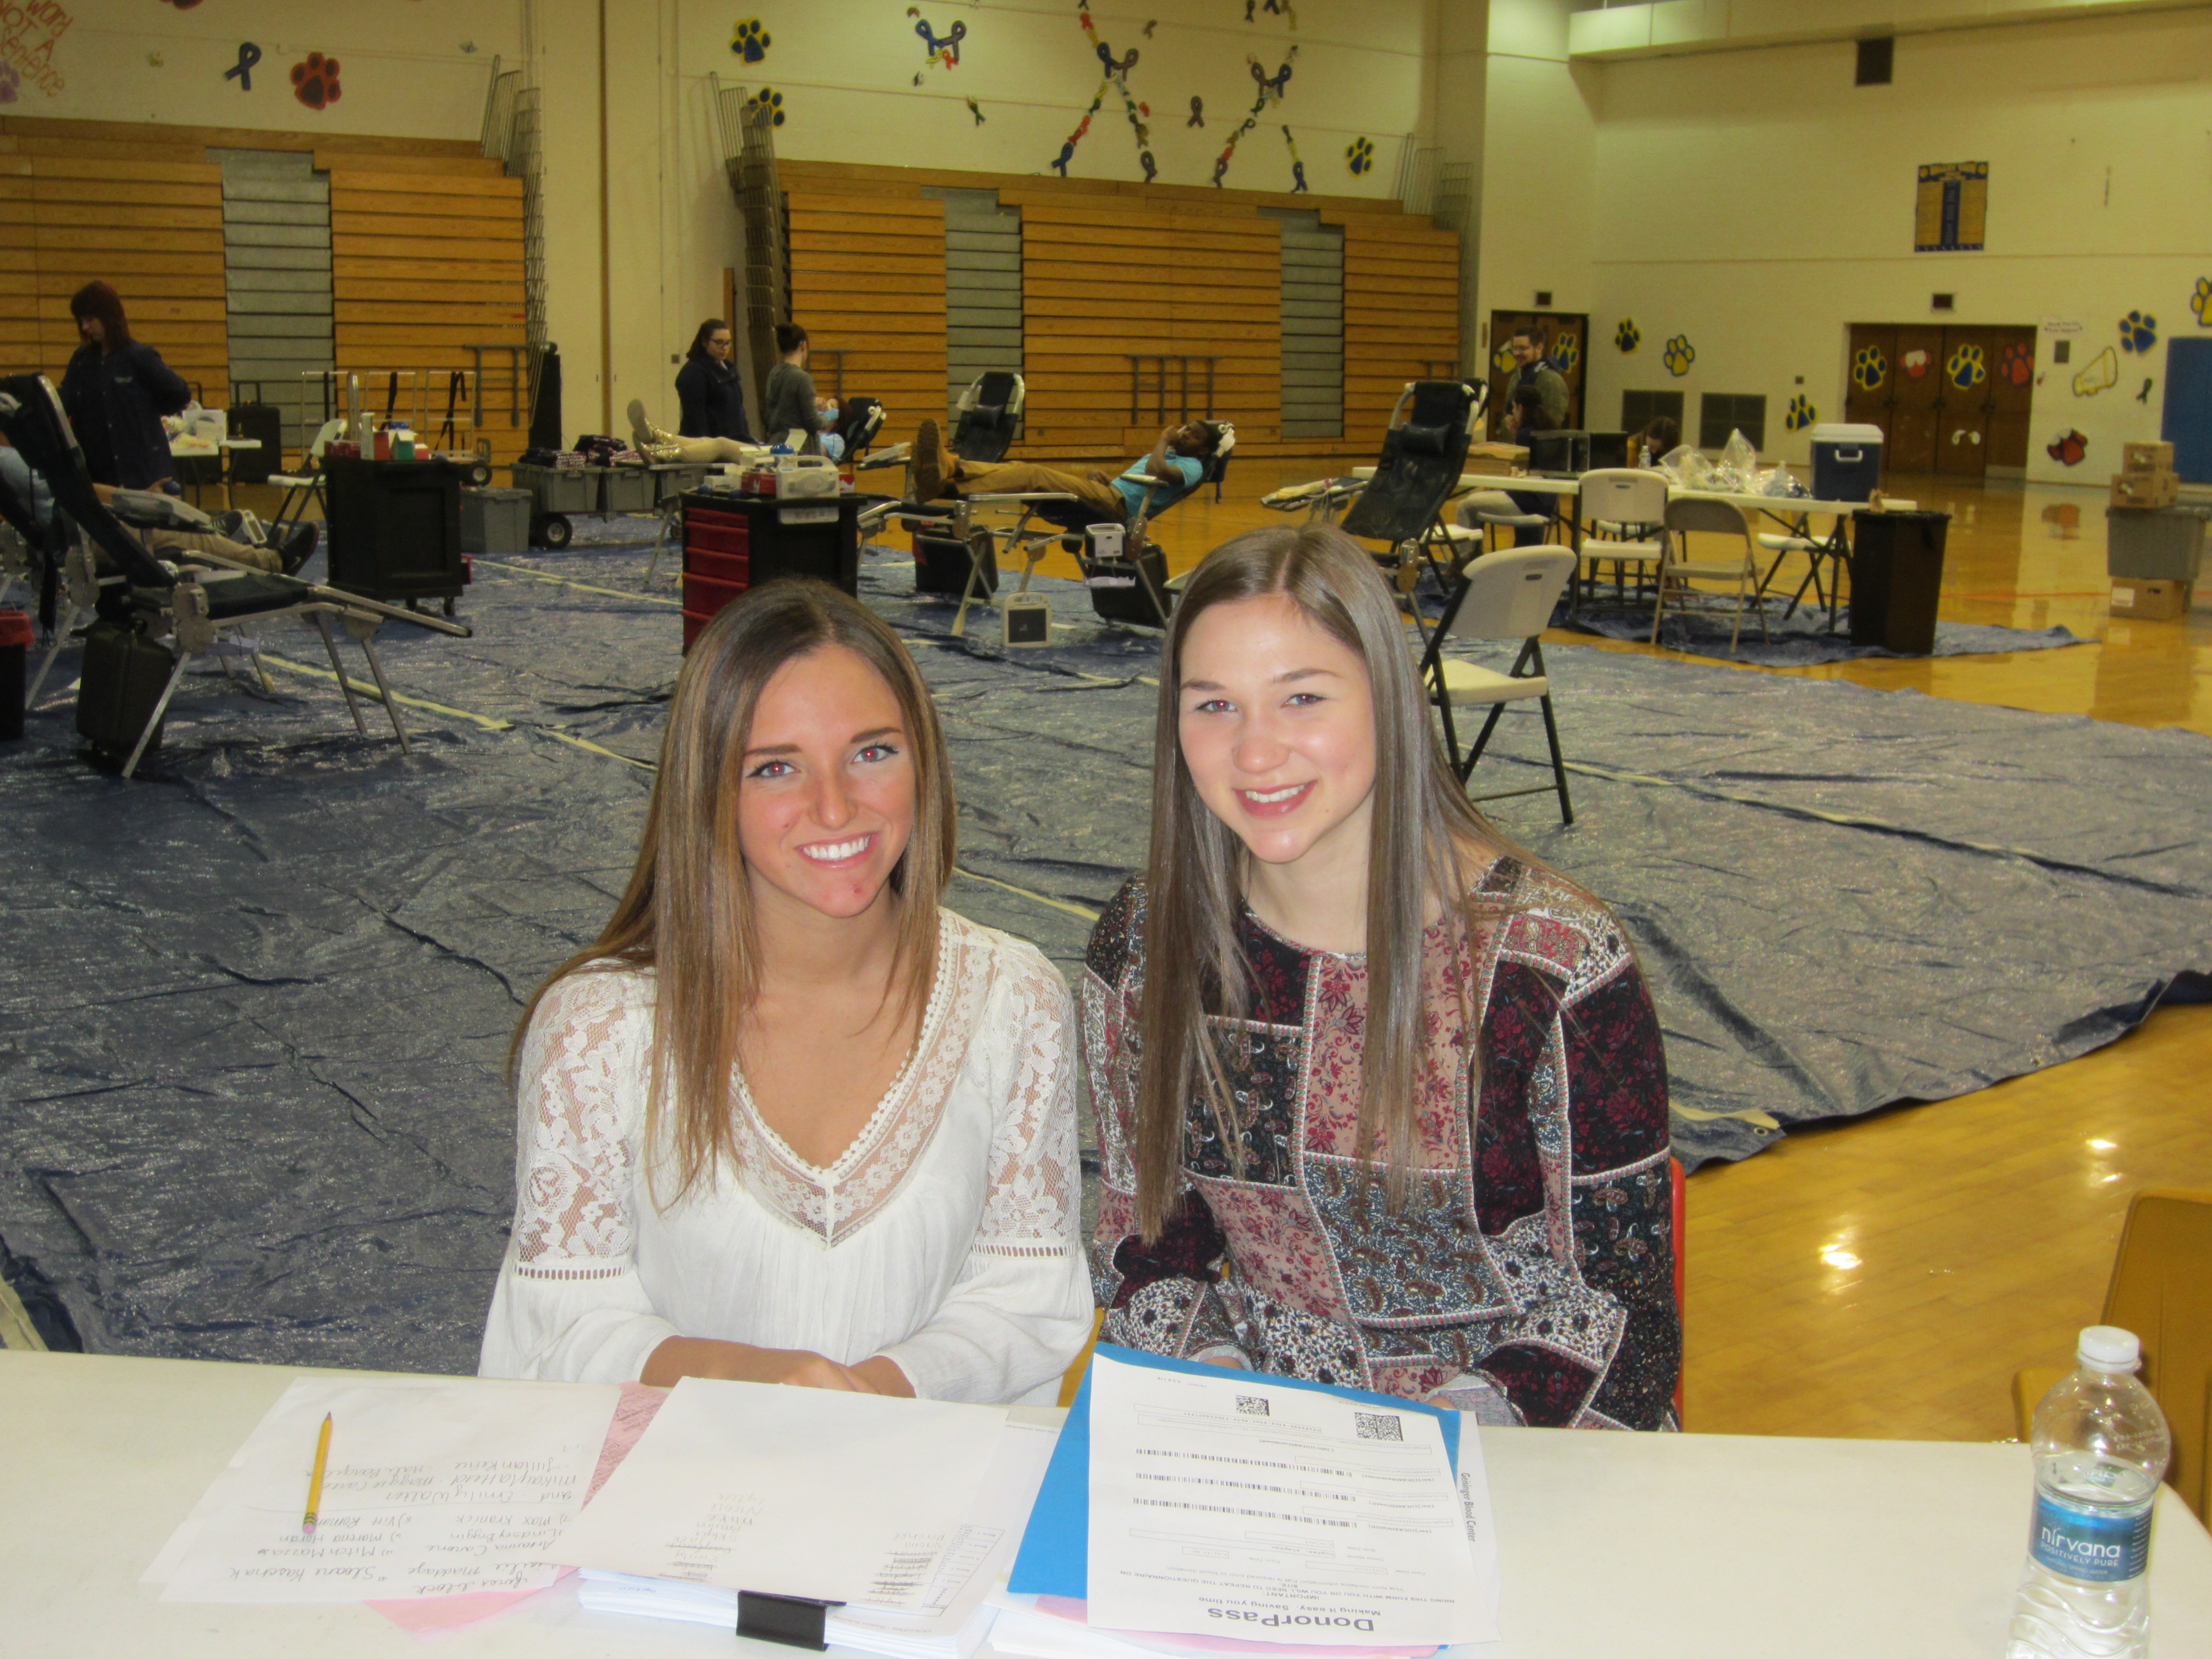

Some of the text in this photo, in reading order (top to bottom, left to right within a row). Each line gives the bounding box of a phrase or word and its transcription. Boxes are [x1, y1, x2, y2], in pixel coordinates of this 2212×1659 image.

[34, 38, 55, 61] A
[455, 1484, 513, 1503] Emily
[1460, 1473, 1477, 1542] Geisinger Blood Center
[330, 1546, 376, 1557] Mitch
[2042, 1526, 2121, 1558] nirvana
[2040, 1541, 2119, 1567] POSITIVELY PURE
[315, 1566, 376, 1580] Sloane
[1134, 1572, 1199, 1583] QUESTIONNAIRE
[412, 1571, 528, 1595] first block
[1198, 1597, 1223, 1605] time
[1250, 1601, 1289, 1611] Saving
[1207, 1608, 1375, 1632] DonorPass
[1340, 1607, 1381, 1616] Making
